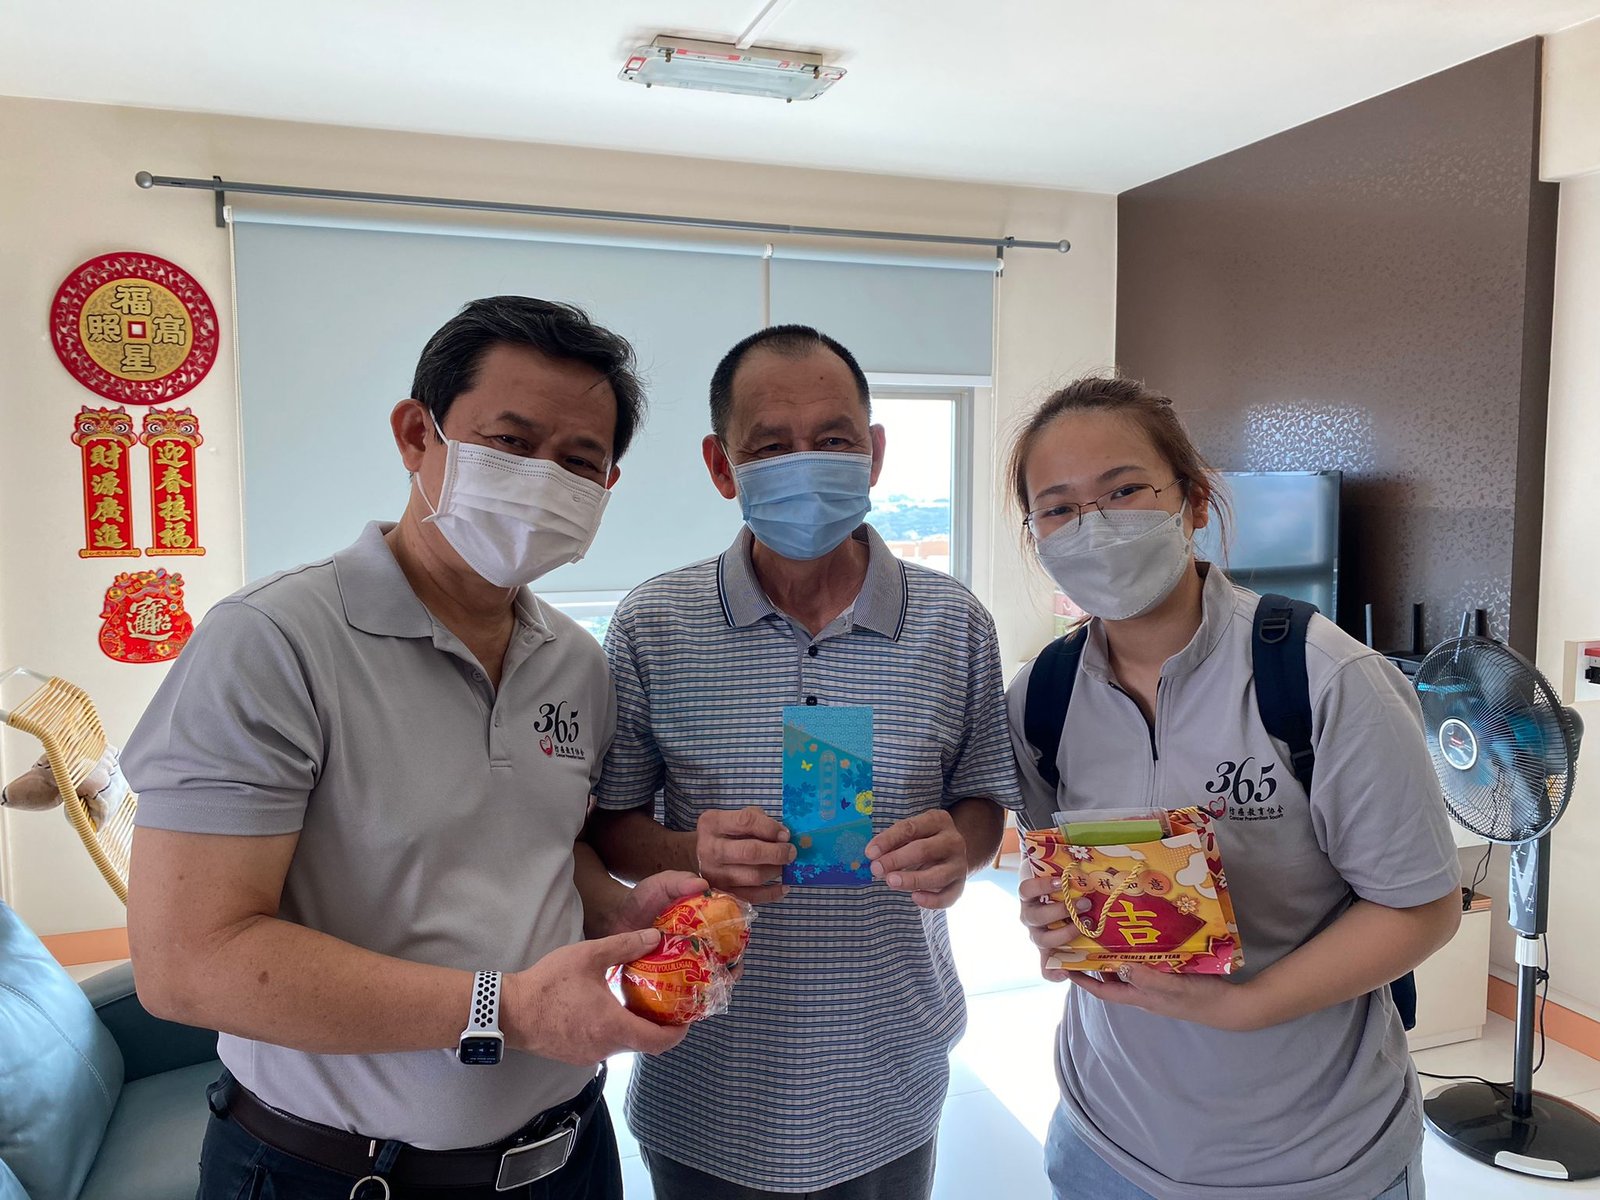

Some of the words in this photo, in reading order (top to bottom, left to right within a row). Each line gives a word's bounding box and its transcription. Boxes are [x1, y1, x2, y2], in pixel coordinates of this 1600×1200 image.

[111, 285, 152, 316] 福
[86, 313, 122, 343] 照
[152, 314, 186, 346] 高
[120, 343, 157, 373] 星
[90, 441, 128, 549] 財源廣進
[155, 441, 193, 548] 迎春接福
[533, 700, 579, 743] 365
[1205, 756, 1277, 805] 365
[1106, 900, 1161, 946] 吉
